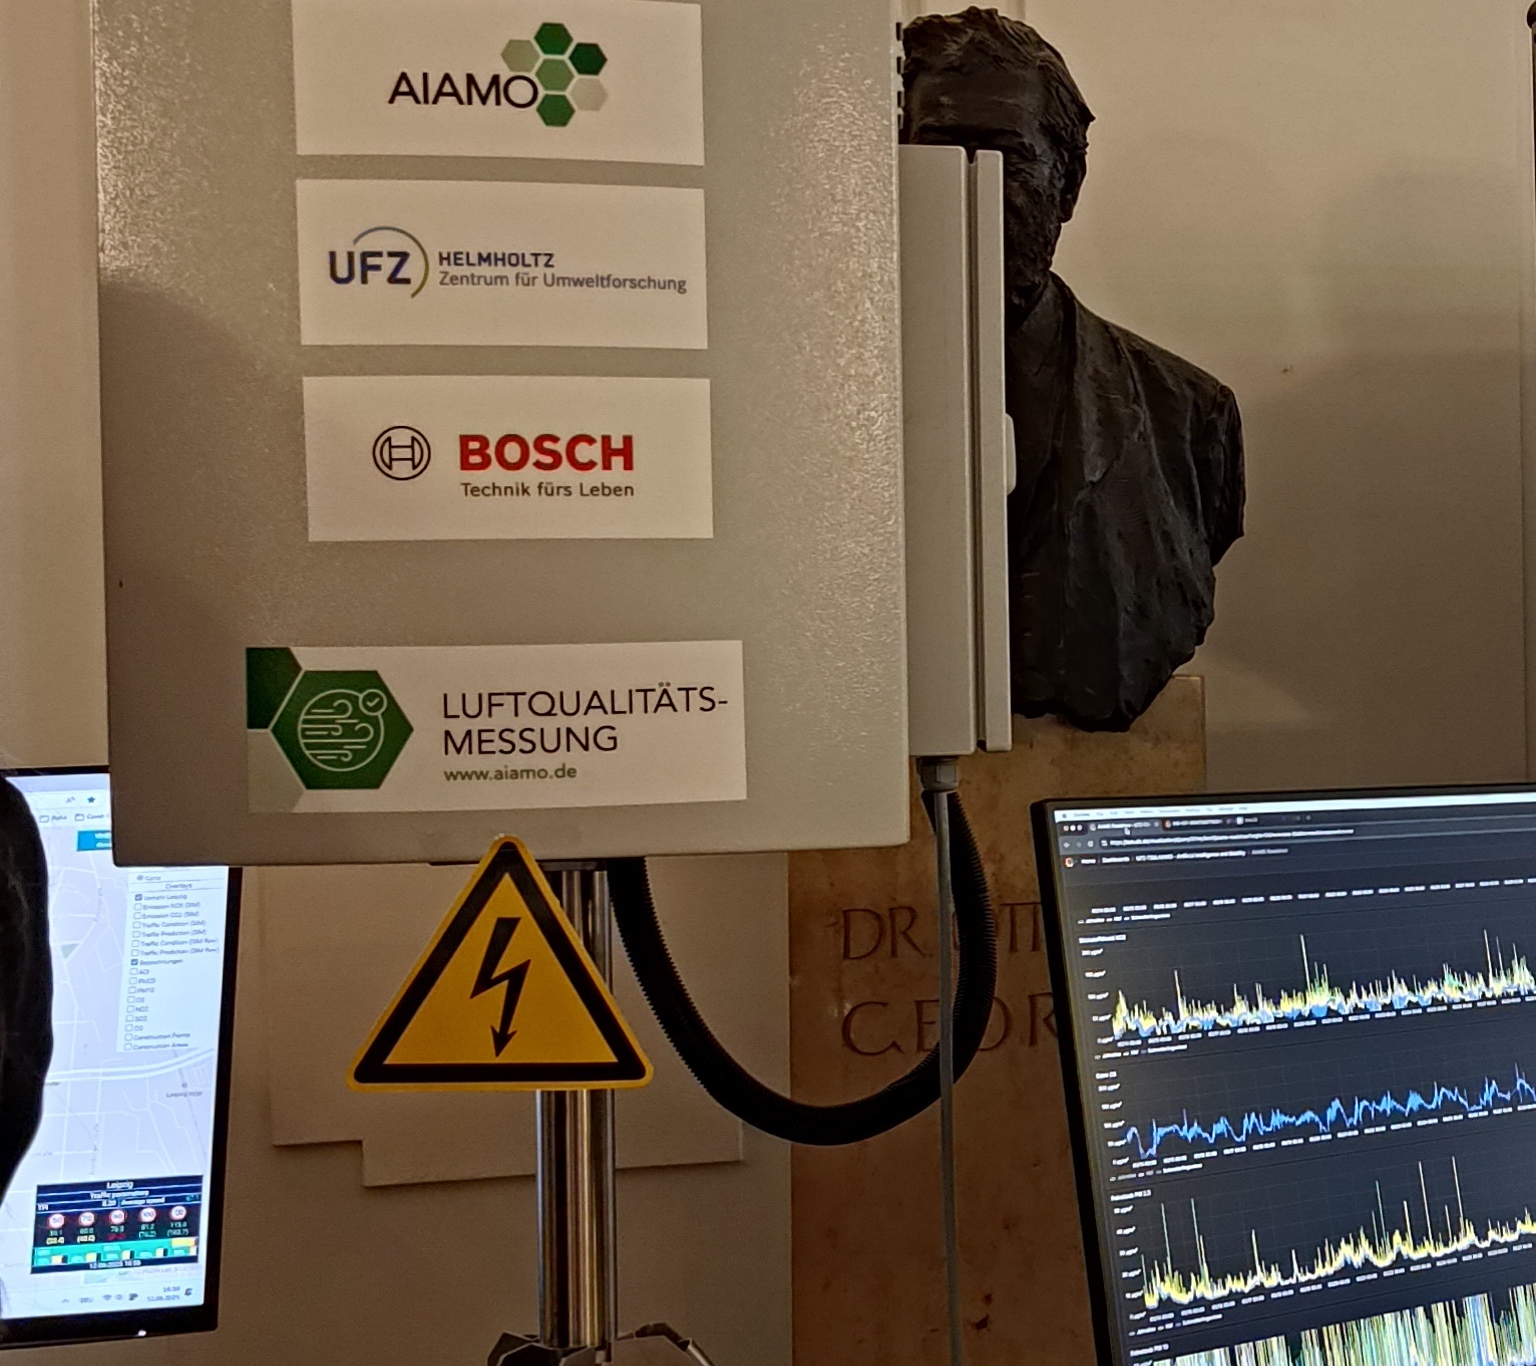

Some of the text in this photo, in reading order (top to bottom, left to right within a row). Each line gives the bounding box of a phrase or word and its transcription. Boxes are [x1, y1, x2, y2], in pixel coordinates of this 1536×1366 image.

[388, 72, 538, 108] AIAMO
[328, 251, 411, 285] UFZ
[438, 252, 554, 268] HELMHOLTZ
[438, 271, 687, 294] Zentrum für Umweltforschung
[458, 433, 634, 470] BOSCH
[460, 481, 634, 497] Technik fürs Leben
[443, 681, 729, 719] LUFTQUALITÄTS-
[444, 726, 618, 755] MESSUNG
[443, 763, 577, 780] www.aiamo.de
